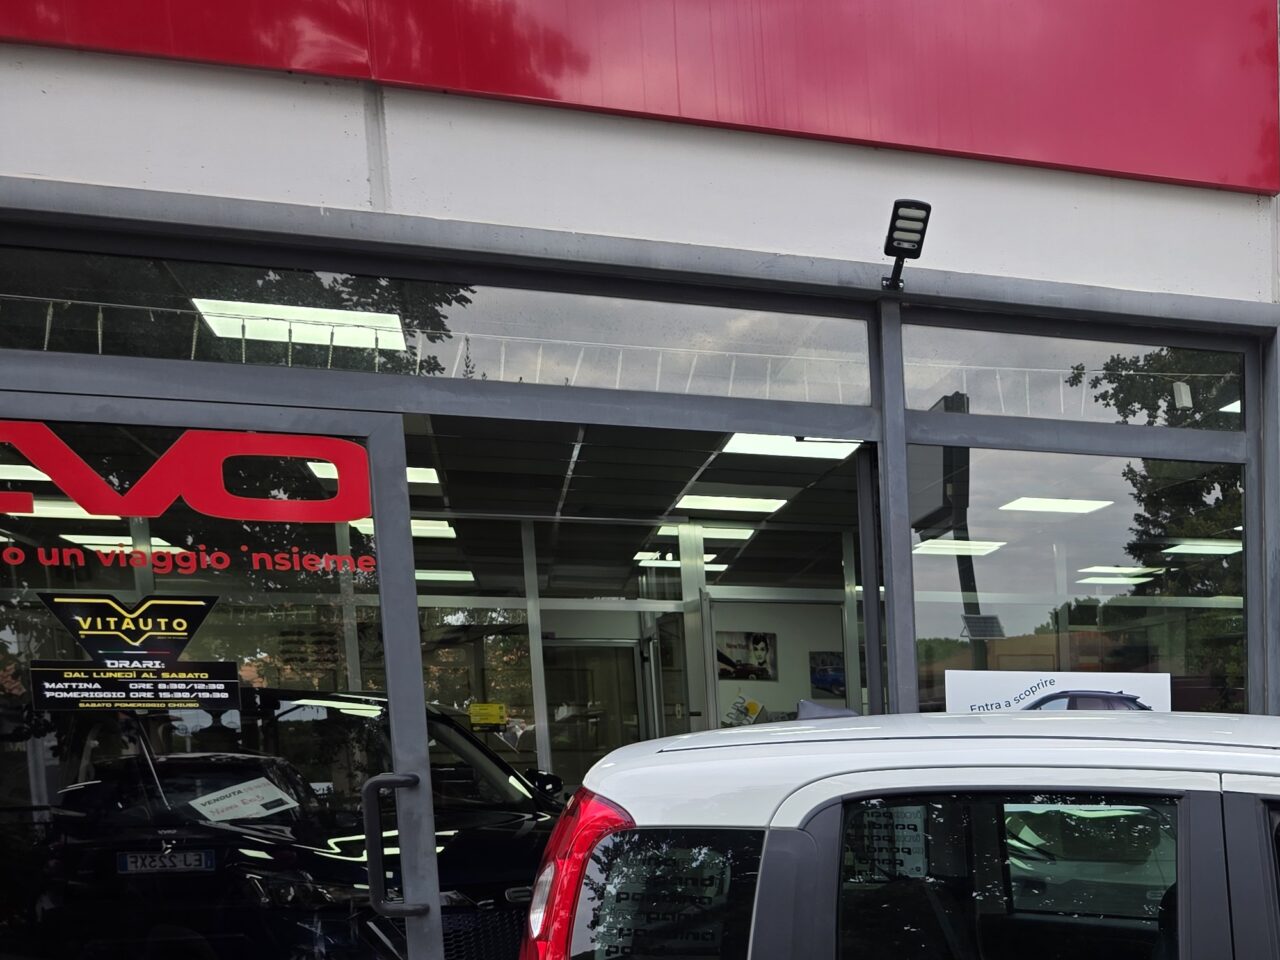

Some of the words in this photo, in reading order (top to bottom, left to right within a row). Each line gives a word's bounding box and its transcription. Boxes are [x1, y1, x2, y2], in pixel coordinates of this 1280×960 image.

[0, 420, 373, 523] VO
[37, 547, 85, 567] un
[95, 543, 231, 574] viaggio
[241, 545, 376, 572] nsieme
[76, 616, 188, 631] VITAUTO
[105, 660, 165, 668] ORARI:
[970, 701, 1001, 712] Entra
[1004, 700, 1011, 708] a
[1013, 677, 1056, 705] scoprire
[199, 789, 244, 808] VENDUTA
